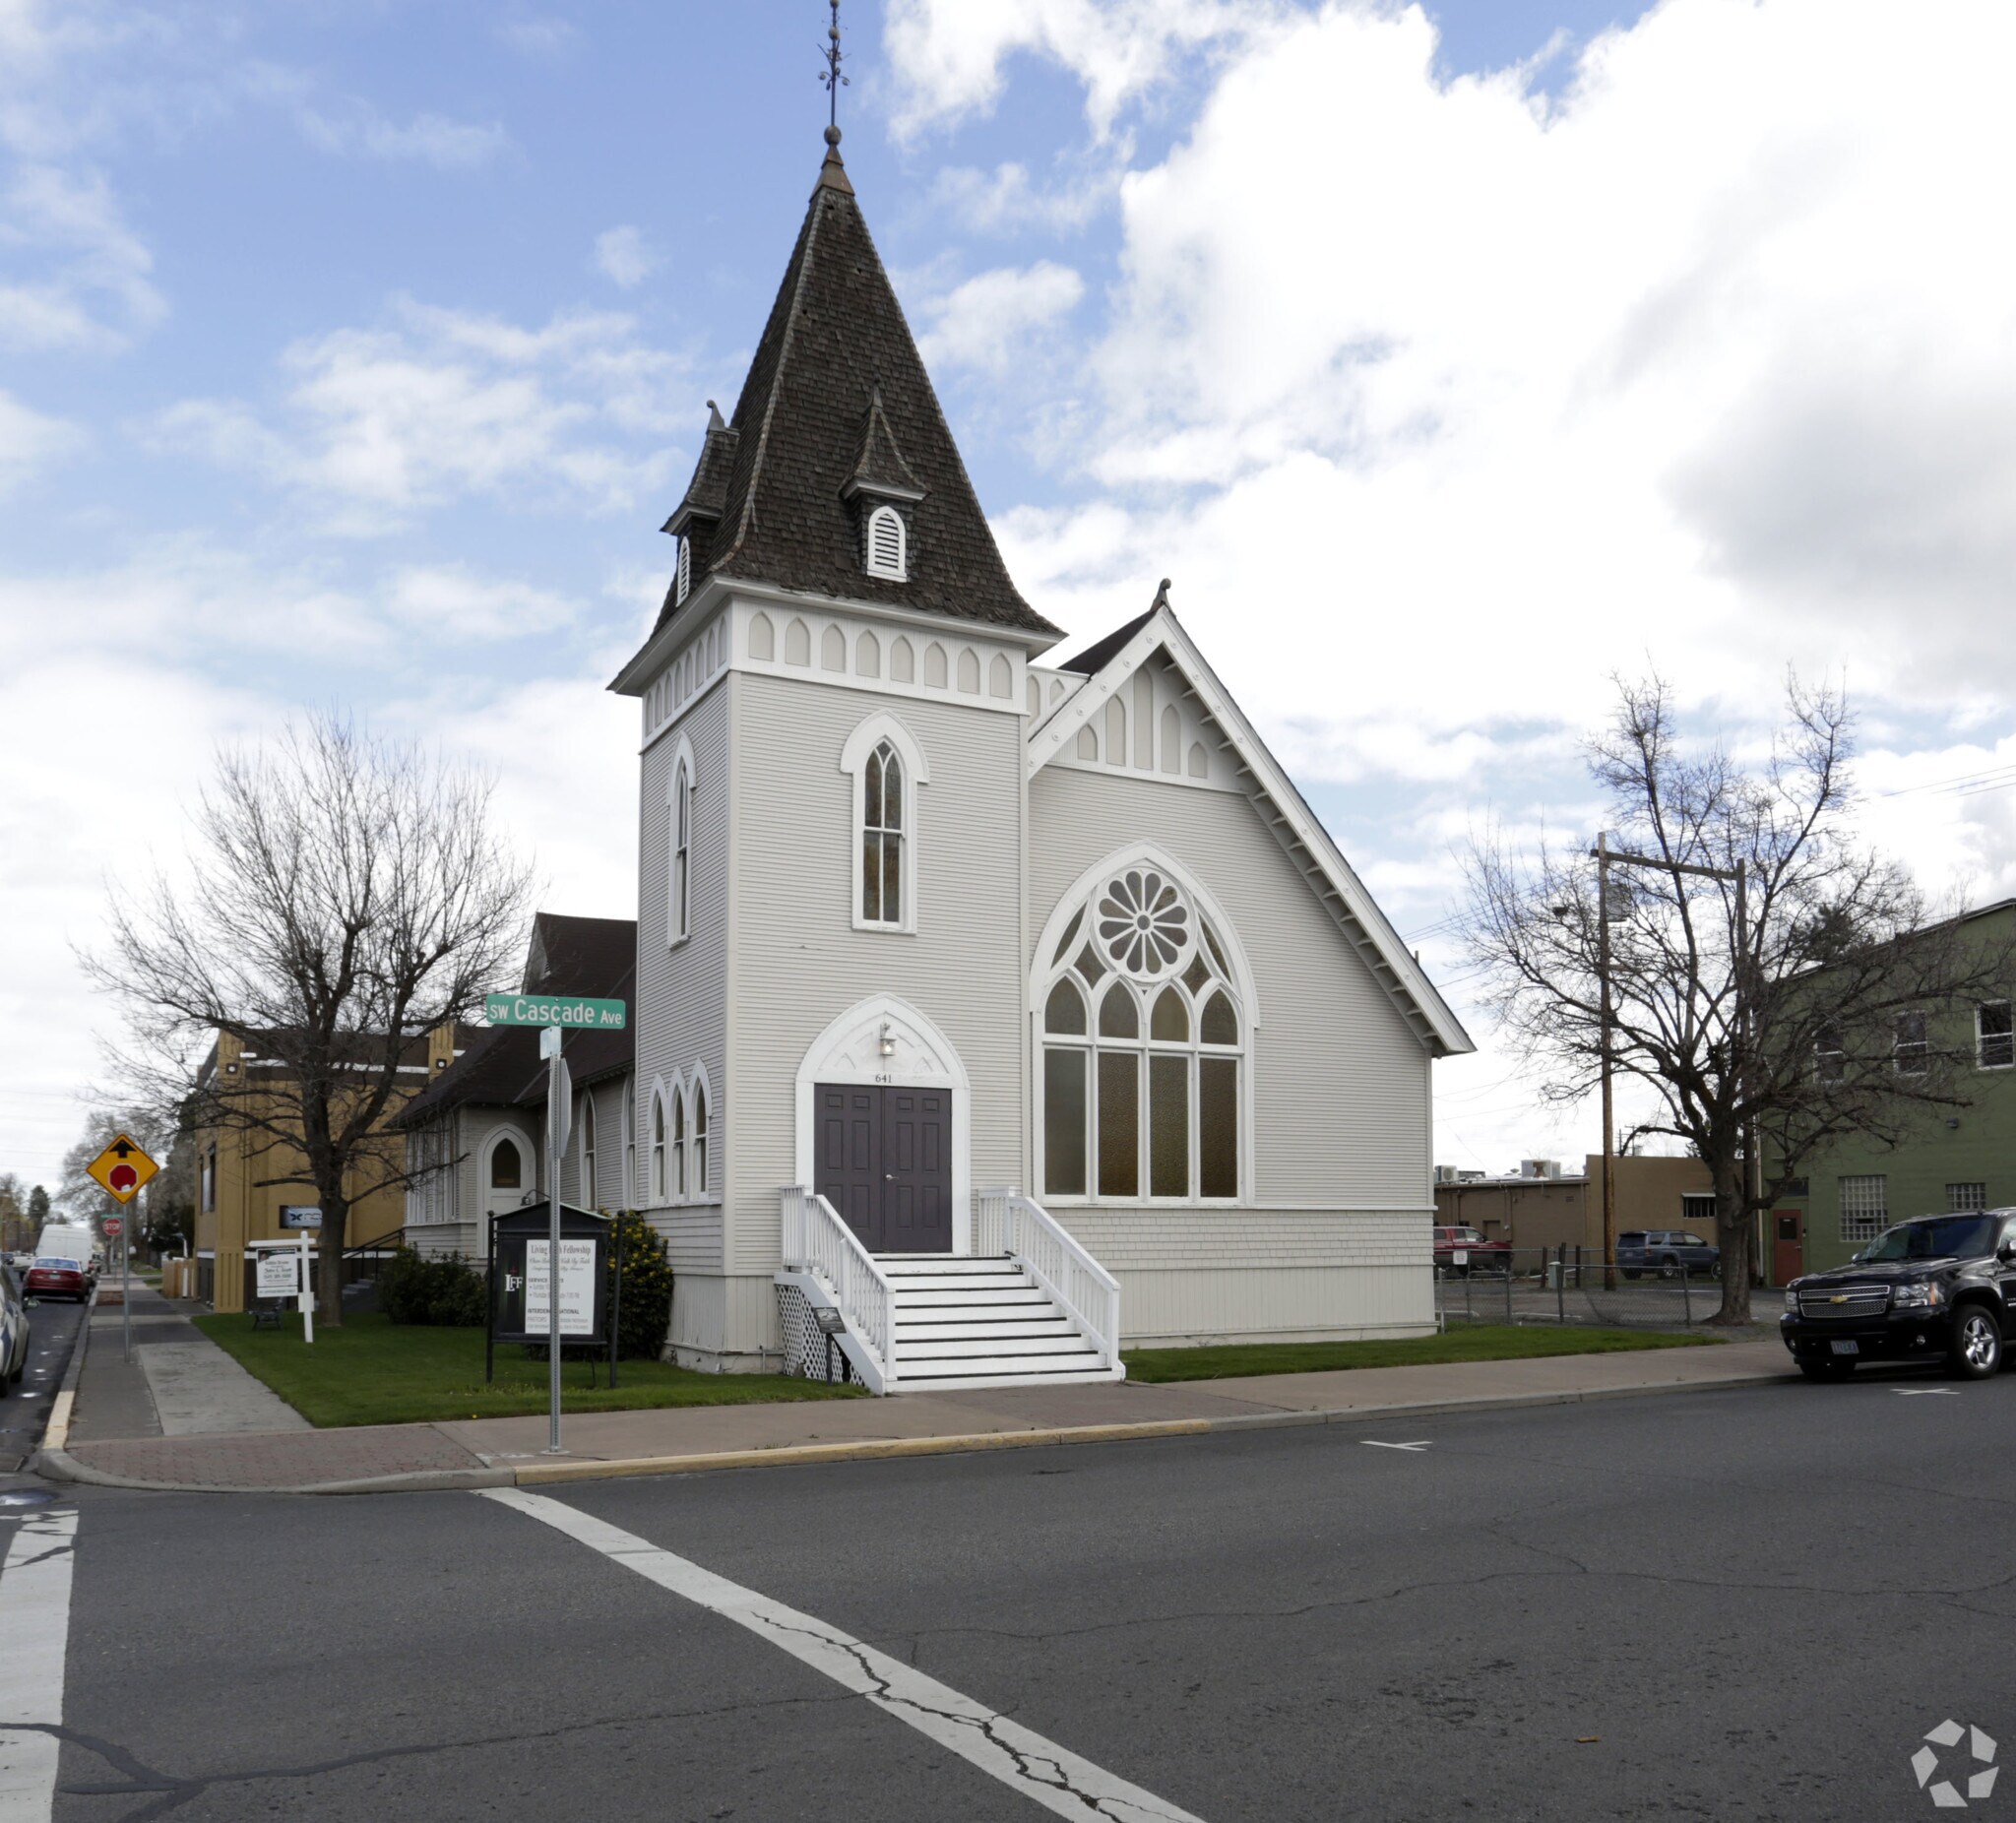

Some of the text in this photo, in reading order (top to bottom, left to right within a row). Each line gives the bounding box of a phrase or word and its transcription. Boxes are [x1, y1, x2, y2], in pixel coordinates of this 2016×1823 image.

[489, 998, 622, 1025] SW Cascade Ave
[875, 1073, 892, 1083] 641
[531, 1244, 548, 1255] Living
[563, 1244, 591, 1256] Fellowship
[504, 1274, 524, 1291] LFF
